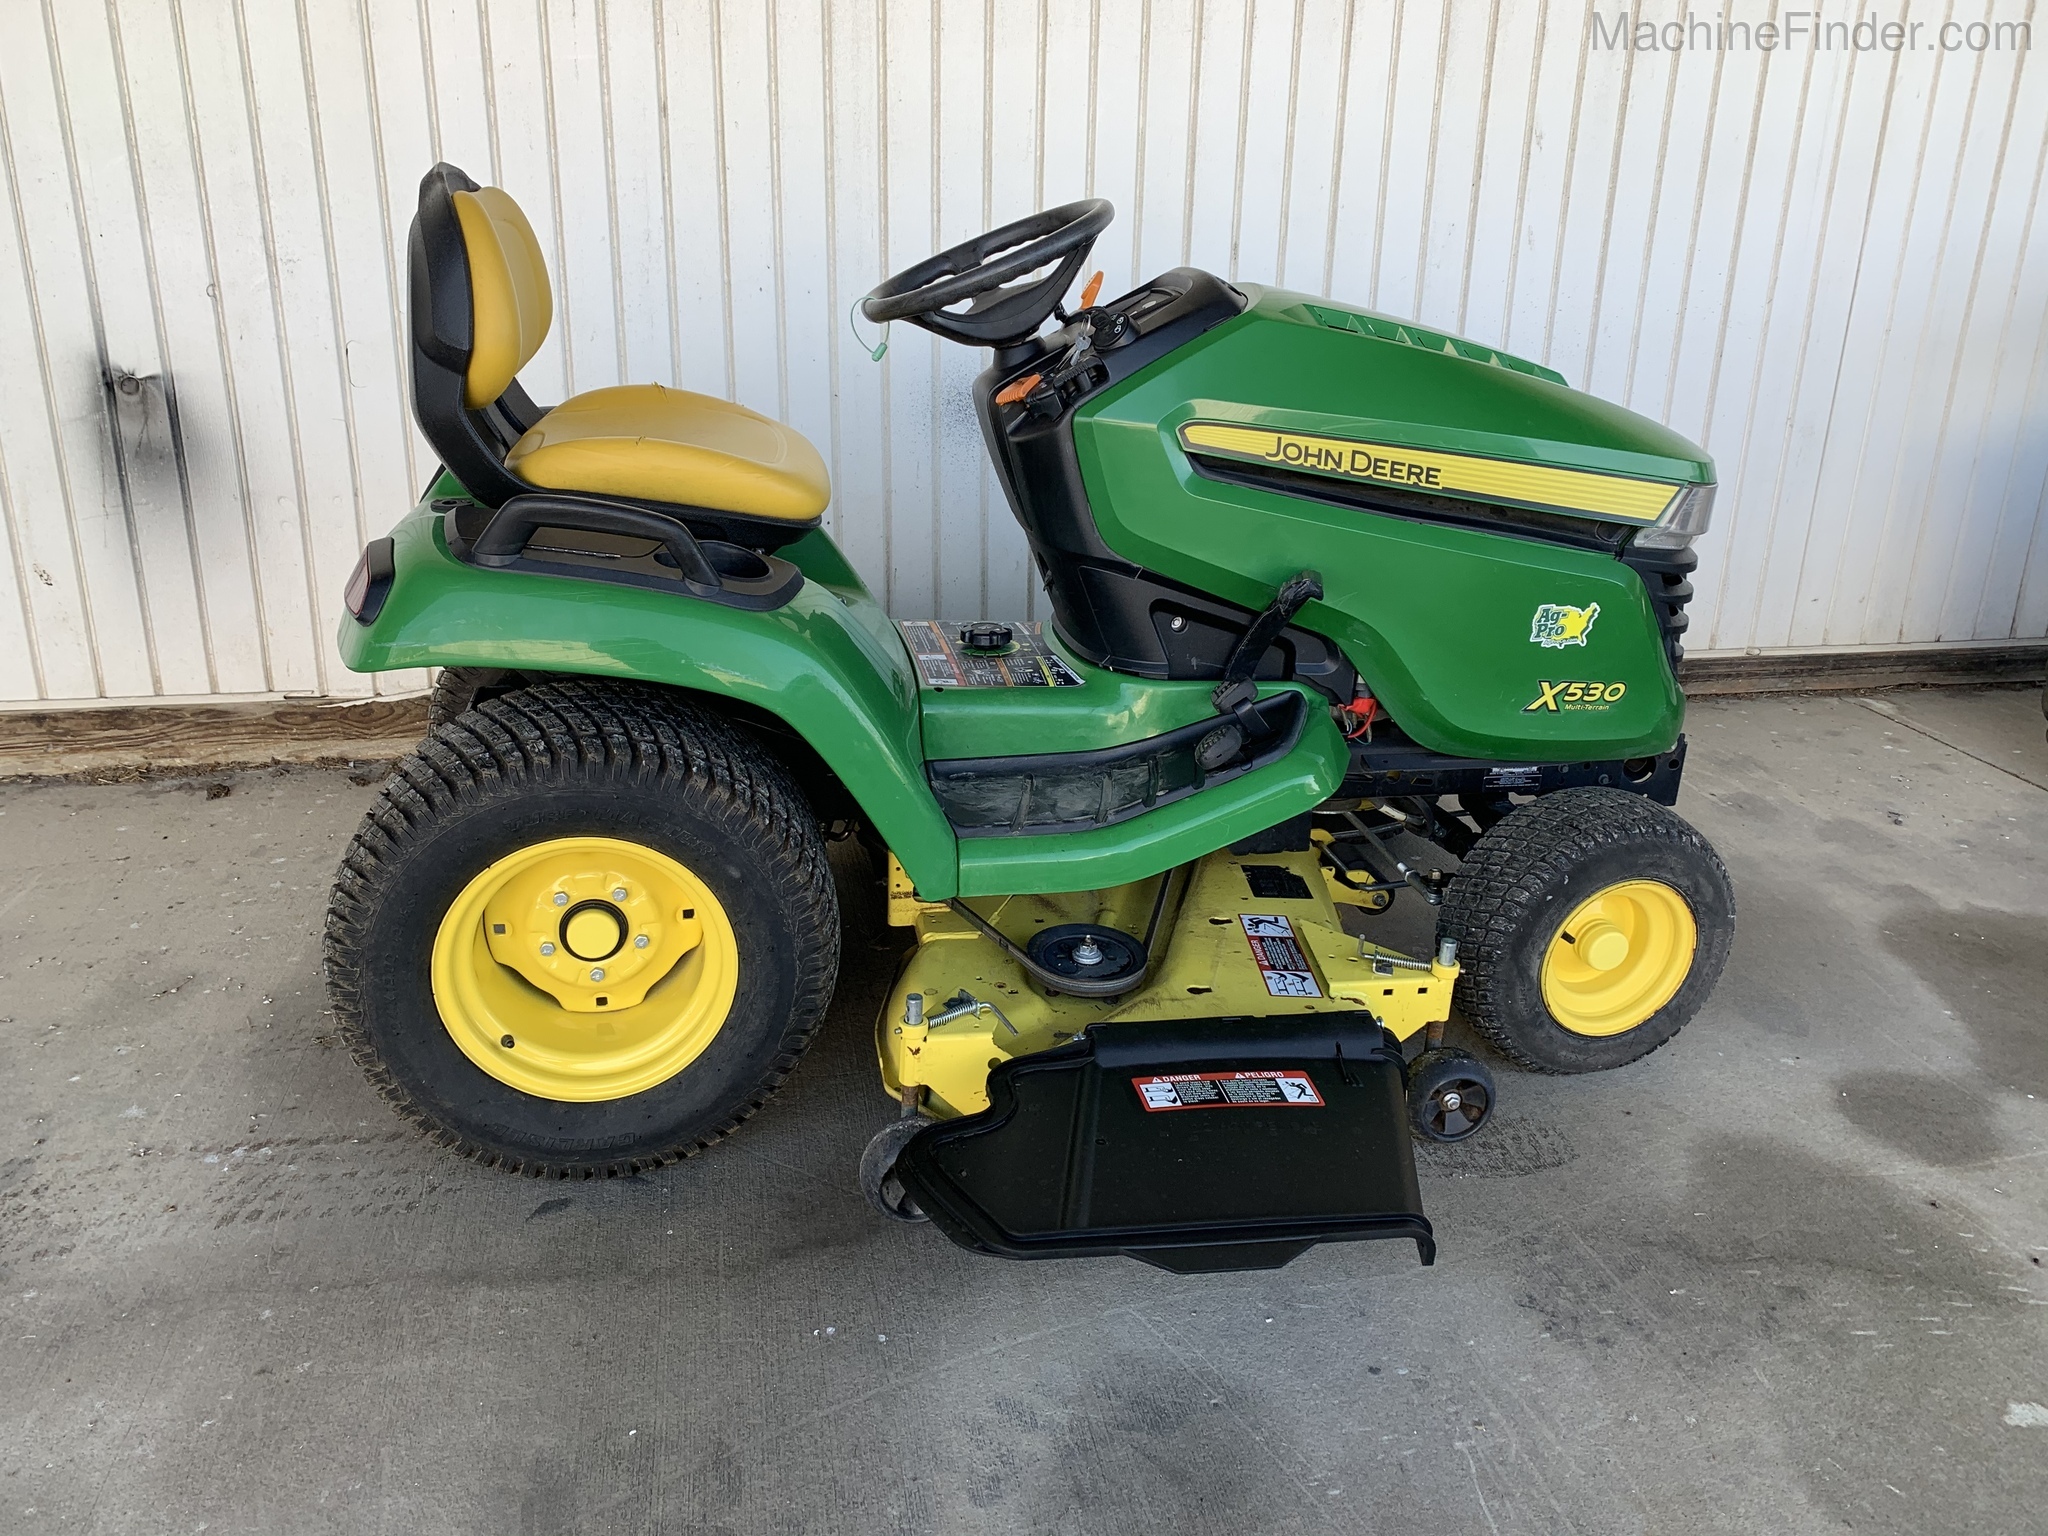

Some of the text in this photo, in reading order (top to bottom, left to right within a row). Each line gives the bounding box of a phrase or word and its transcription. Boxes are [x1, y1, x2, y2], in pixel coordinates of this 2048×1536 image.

[1265, 436, 1442, 487] JOHN DEERE
[1537, 608, 1568, 625] Ag-
[1534, 623, 1565, 638] Pro
[1522, 680, 1626, 712] X530
[1250, 940, 1266, 961] DANGER
[1162, 1074, 1201, 1082] DANGER
[1245, 1071, 1284, 1079] PELIGRO
